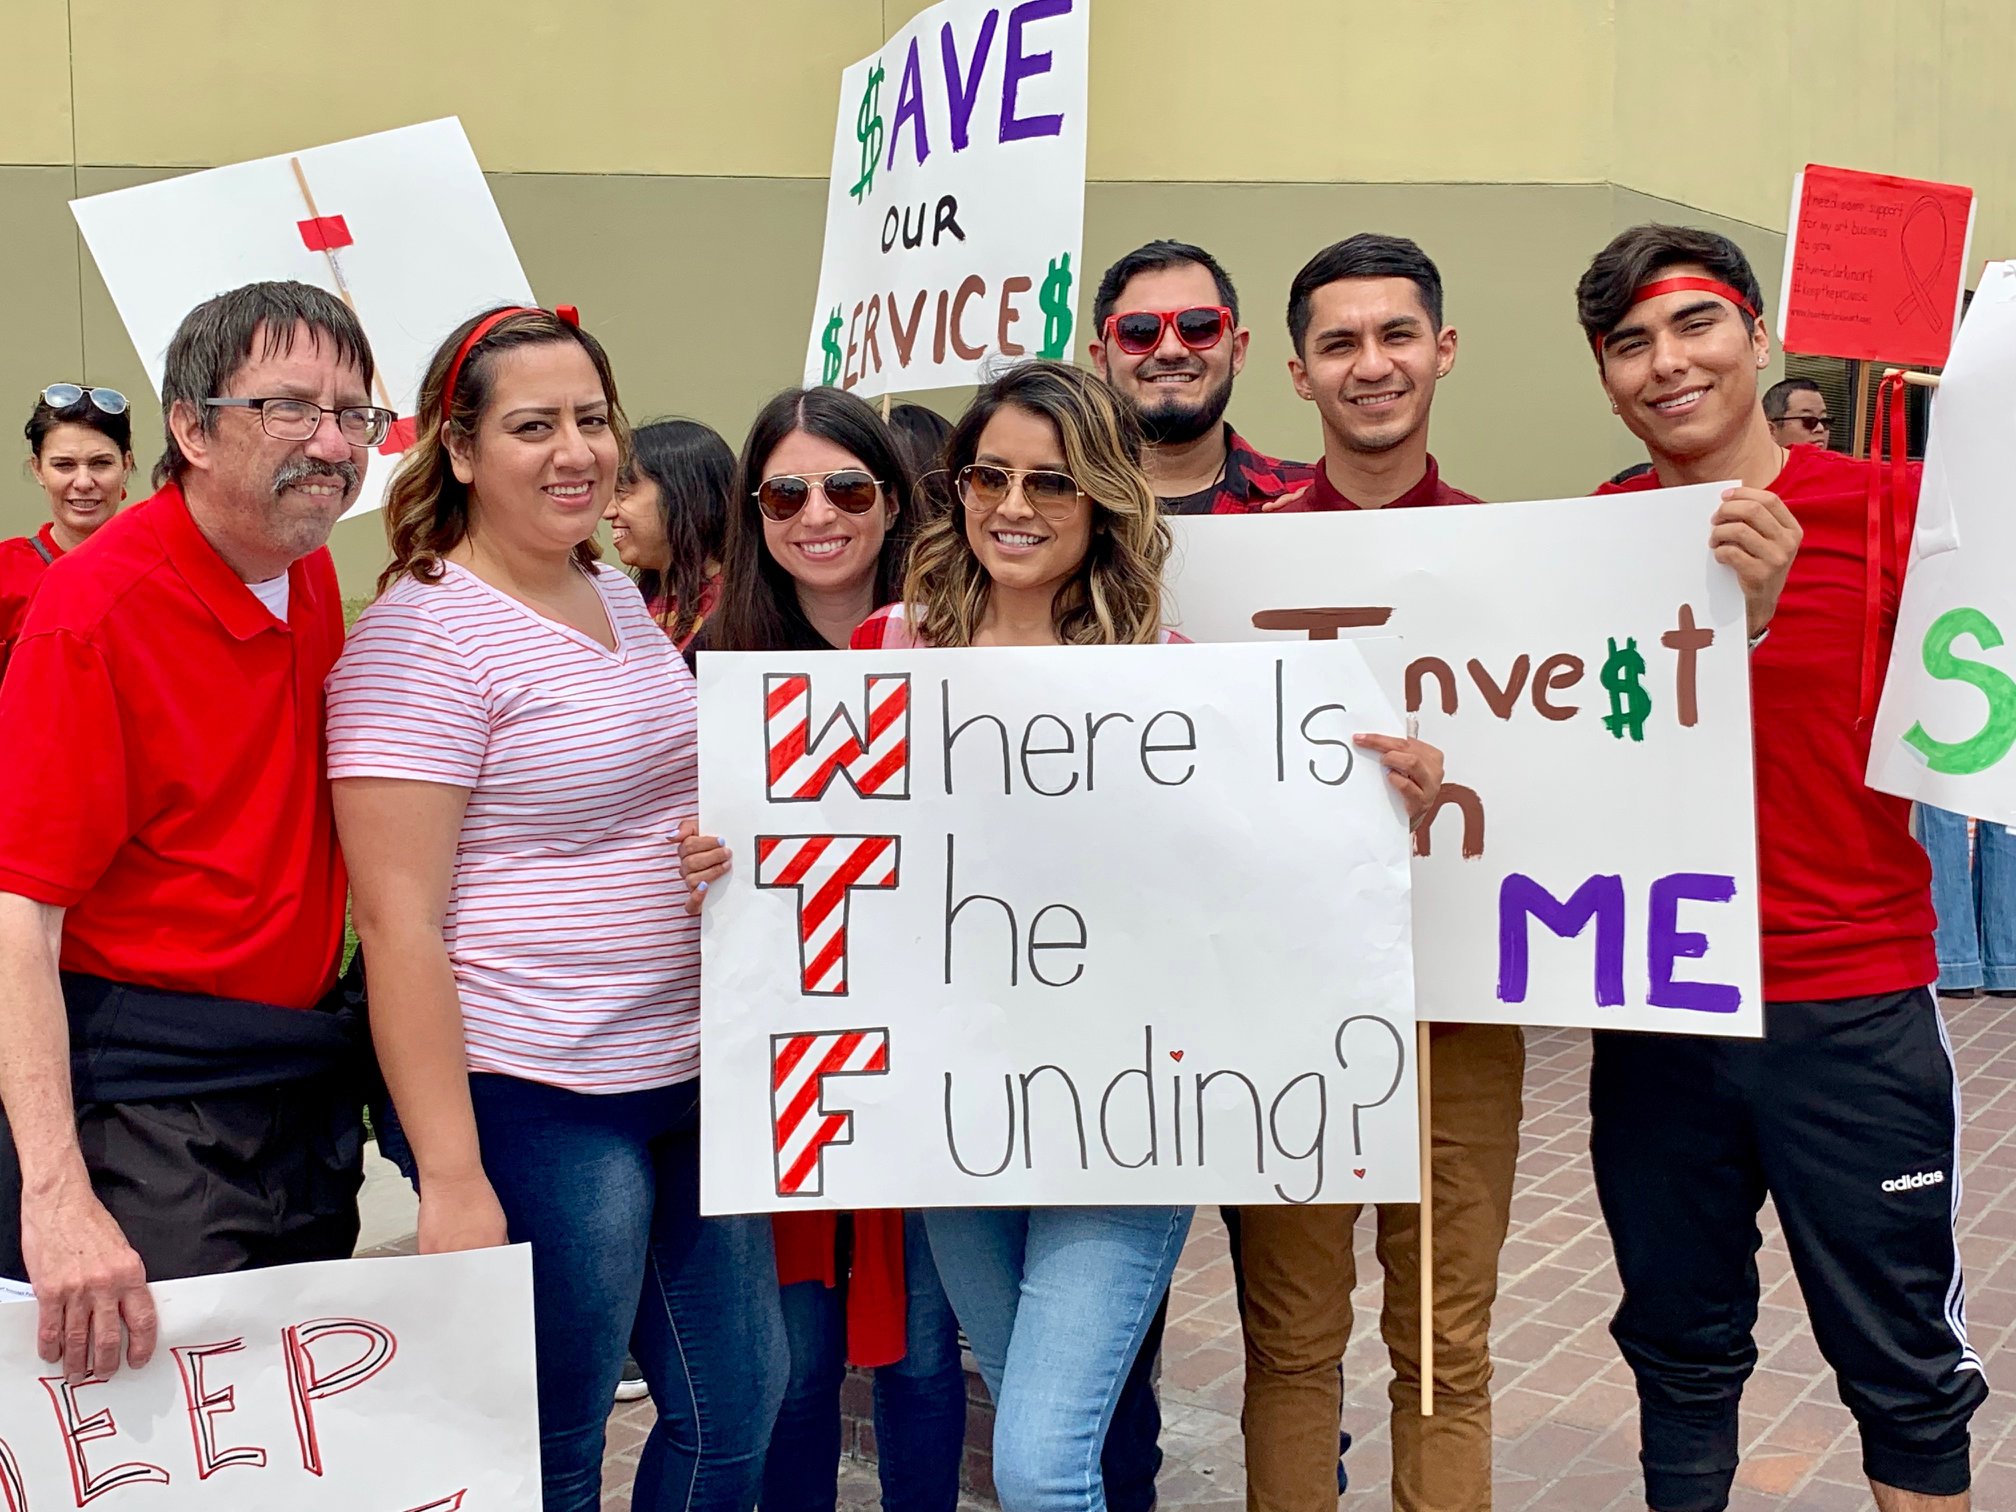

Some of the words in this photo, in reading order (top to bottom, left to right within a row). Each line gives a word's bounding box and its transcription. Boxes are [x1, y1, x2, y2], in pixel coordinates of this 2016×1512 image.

[849, 0, 1073, 205] $AVE
[881, 194, 966, 254] OUR
[1800, 237, 1810, 250] to
[1811, 242, 1832, 255] grow
[1801, 211, 1817, 229] for
[1820, 221, 1832, 236] my
[1834, 219, 1848, 232] art
[1851, 220, 1888, 238] business
[1812, 192, 1838, 209] need
[1841, 201, 1865, 211] some
[1868, 202, 1904, 220] support
[821, 252, 1073, 390] $ERVICE$
[763, 673, 1197, 803] Where
[1275, 659, 1354, 787] Is
[1413, 783, 1485, 862] n
[755, 834, 1088, 997] The
[1496, 872, 1742, 1014] ME
[770, 1015, 1405, 1204] Funding?
[1881, 1170, 1944, 1192] adidas
